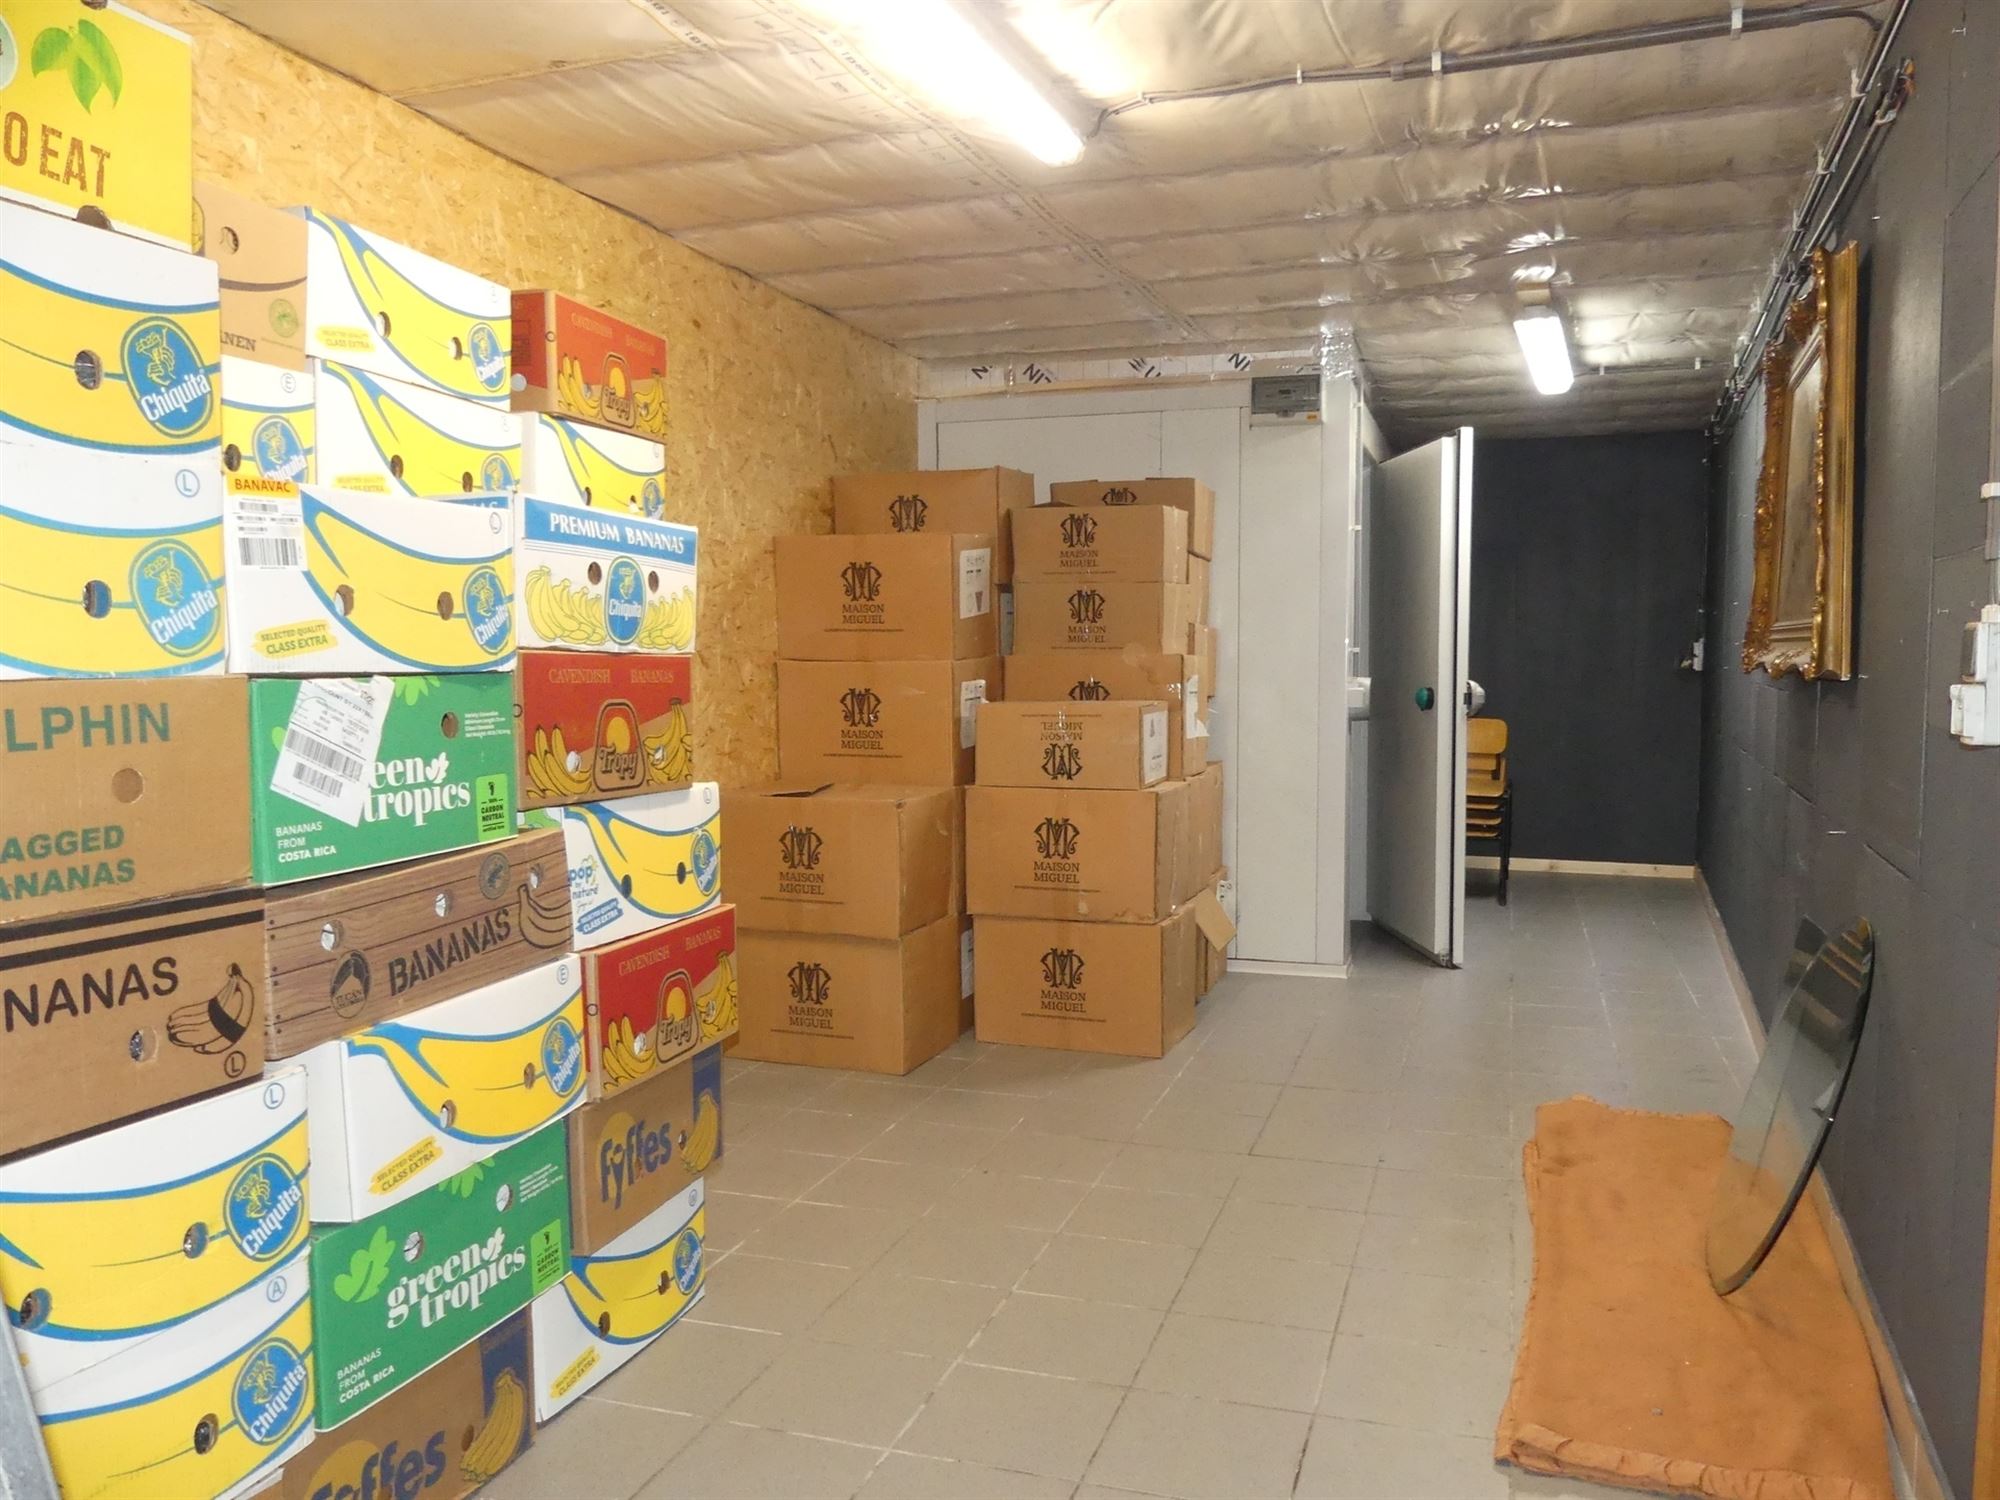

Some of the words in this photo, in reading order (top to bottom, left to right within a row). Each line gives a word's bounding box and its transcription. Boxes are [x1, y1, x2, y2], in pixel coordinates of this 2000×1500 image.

[39, 123, 111, 198] EAT
[141, 373, 212, 423] Chiquita
[234, 478, 291, 494] BANAVAC
[549, 512, 620, 543] PREMIUM
[625, 526, 685, 554] BANANAS
[1059, 550, 1099, 559] MAISON
[1059, 559, 1099, 568] MIGUEL
[151, 588, 218, 645] Chiquita
[609, 598, 642, 621] Chiquita
[841, 603, 885, 614] MAISON
[474, 605, 508, 645] Chiquita
[842, 614, 886, 625] MIGUEL
[1067, 625, 1107, 634] MAISON
[261, 630, 295, 642] SELECTED
[296, 624, 328, 637] QUALITY
[1067, 634, 1106, 644] MIGUEL
[266, 640, 297, 655] CLASS
[298, 635, 329, 649] EXTRA
[548, 668, 611, 684] CAVENDISH
[630, 668, 675, 684] BANANAS
[4, 702, 171, 752] LPHIN
[840, 729, 884, 740] MAISON
[840, 739, 884, 751] MIGUEL
[600, 743, 639, 781] Tropy
[362, 781, 472, 828] tropics
[481, 804, 505, 815] CARBON
[481, 812, 505, 822] NEUTRAL
[275, 820, 323, 838] BANANAS
[0, 825, 125, 864] AGGED
[276, 837, 307, 850] FROM
[278, 847, 312, 864] COSTA
[314, 845, 338, 858] RICA
[779, 871, 824, 883] MAISON
[1033, 860, 1080, 873] MAISON
[1033, 872, 1080, 884] MIGUEL
[779, 883, 825, 896] MIGUEL
[388, 908, 512, 997] BANANAS
[618, 945, 671, 977] CAVENDISH
[685, 925, 722, 951] BANANAS
[4, 956, 179, 1032] NANAS
[1040, 989, 1087, 1002] MAISON
[788, 1005, 834, 1018] MAISON
[1040, 1001, 1087, 1014] MIGUEL
[660, 1013, 694, 1047] Tropy
[789, 1016, 834, 1030] MIGUEL
[552, 1041, 580, 1092] Chiquita
[377, 1158, 408, 1184] SELECTED
[407, 1141, 434, 1163] QUALITY
[382, 1168, 409, 1192] CLASS
[408, 1150, 435, 1174] EXTRA
[600, 1119, 673, 1211] fyffes
[241, 1181, 302, 1258] Chiquita
[386, 1243, 482, 1329] green
[420, 1244, 527, 1329] tropics
[337, 1347, 382, 1381] BANANAS
[338, 1369, 366, 1391] FROM
[339, 1379, 371, 1404] COSTA
[372, 1365, 395, 1385] RICA
[250, 1362, 307, 1442] Chiquita
